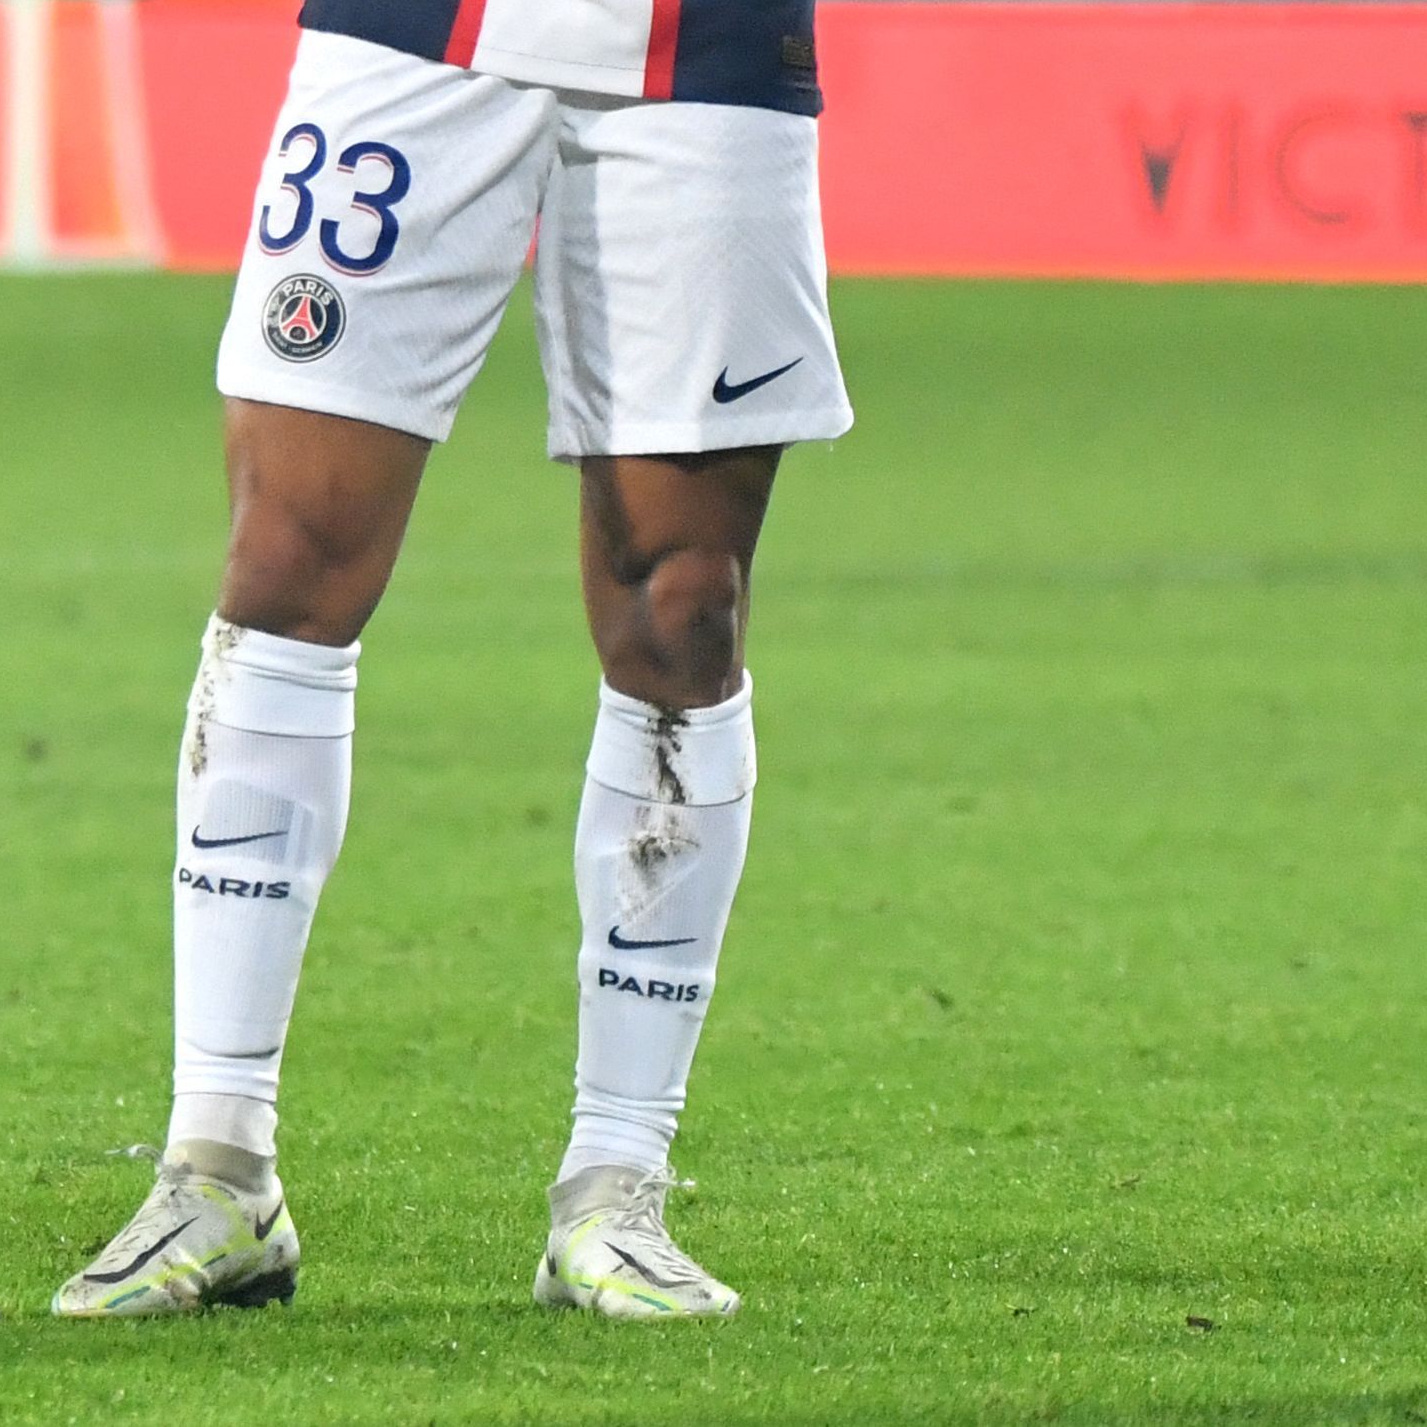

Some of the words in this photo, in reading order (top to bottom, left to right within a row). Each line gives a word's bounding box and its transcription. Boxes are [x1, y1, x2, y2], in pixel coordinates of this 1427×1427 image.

[257, 122, 411, 278] 33
[282, 280, 334, 306] PARIS
[178, 868, 290, 900] PARIS
[598, 968, 699, 1003] PARIS
